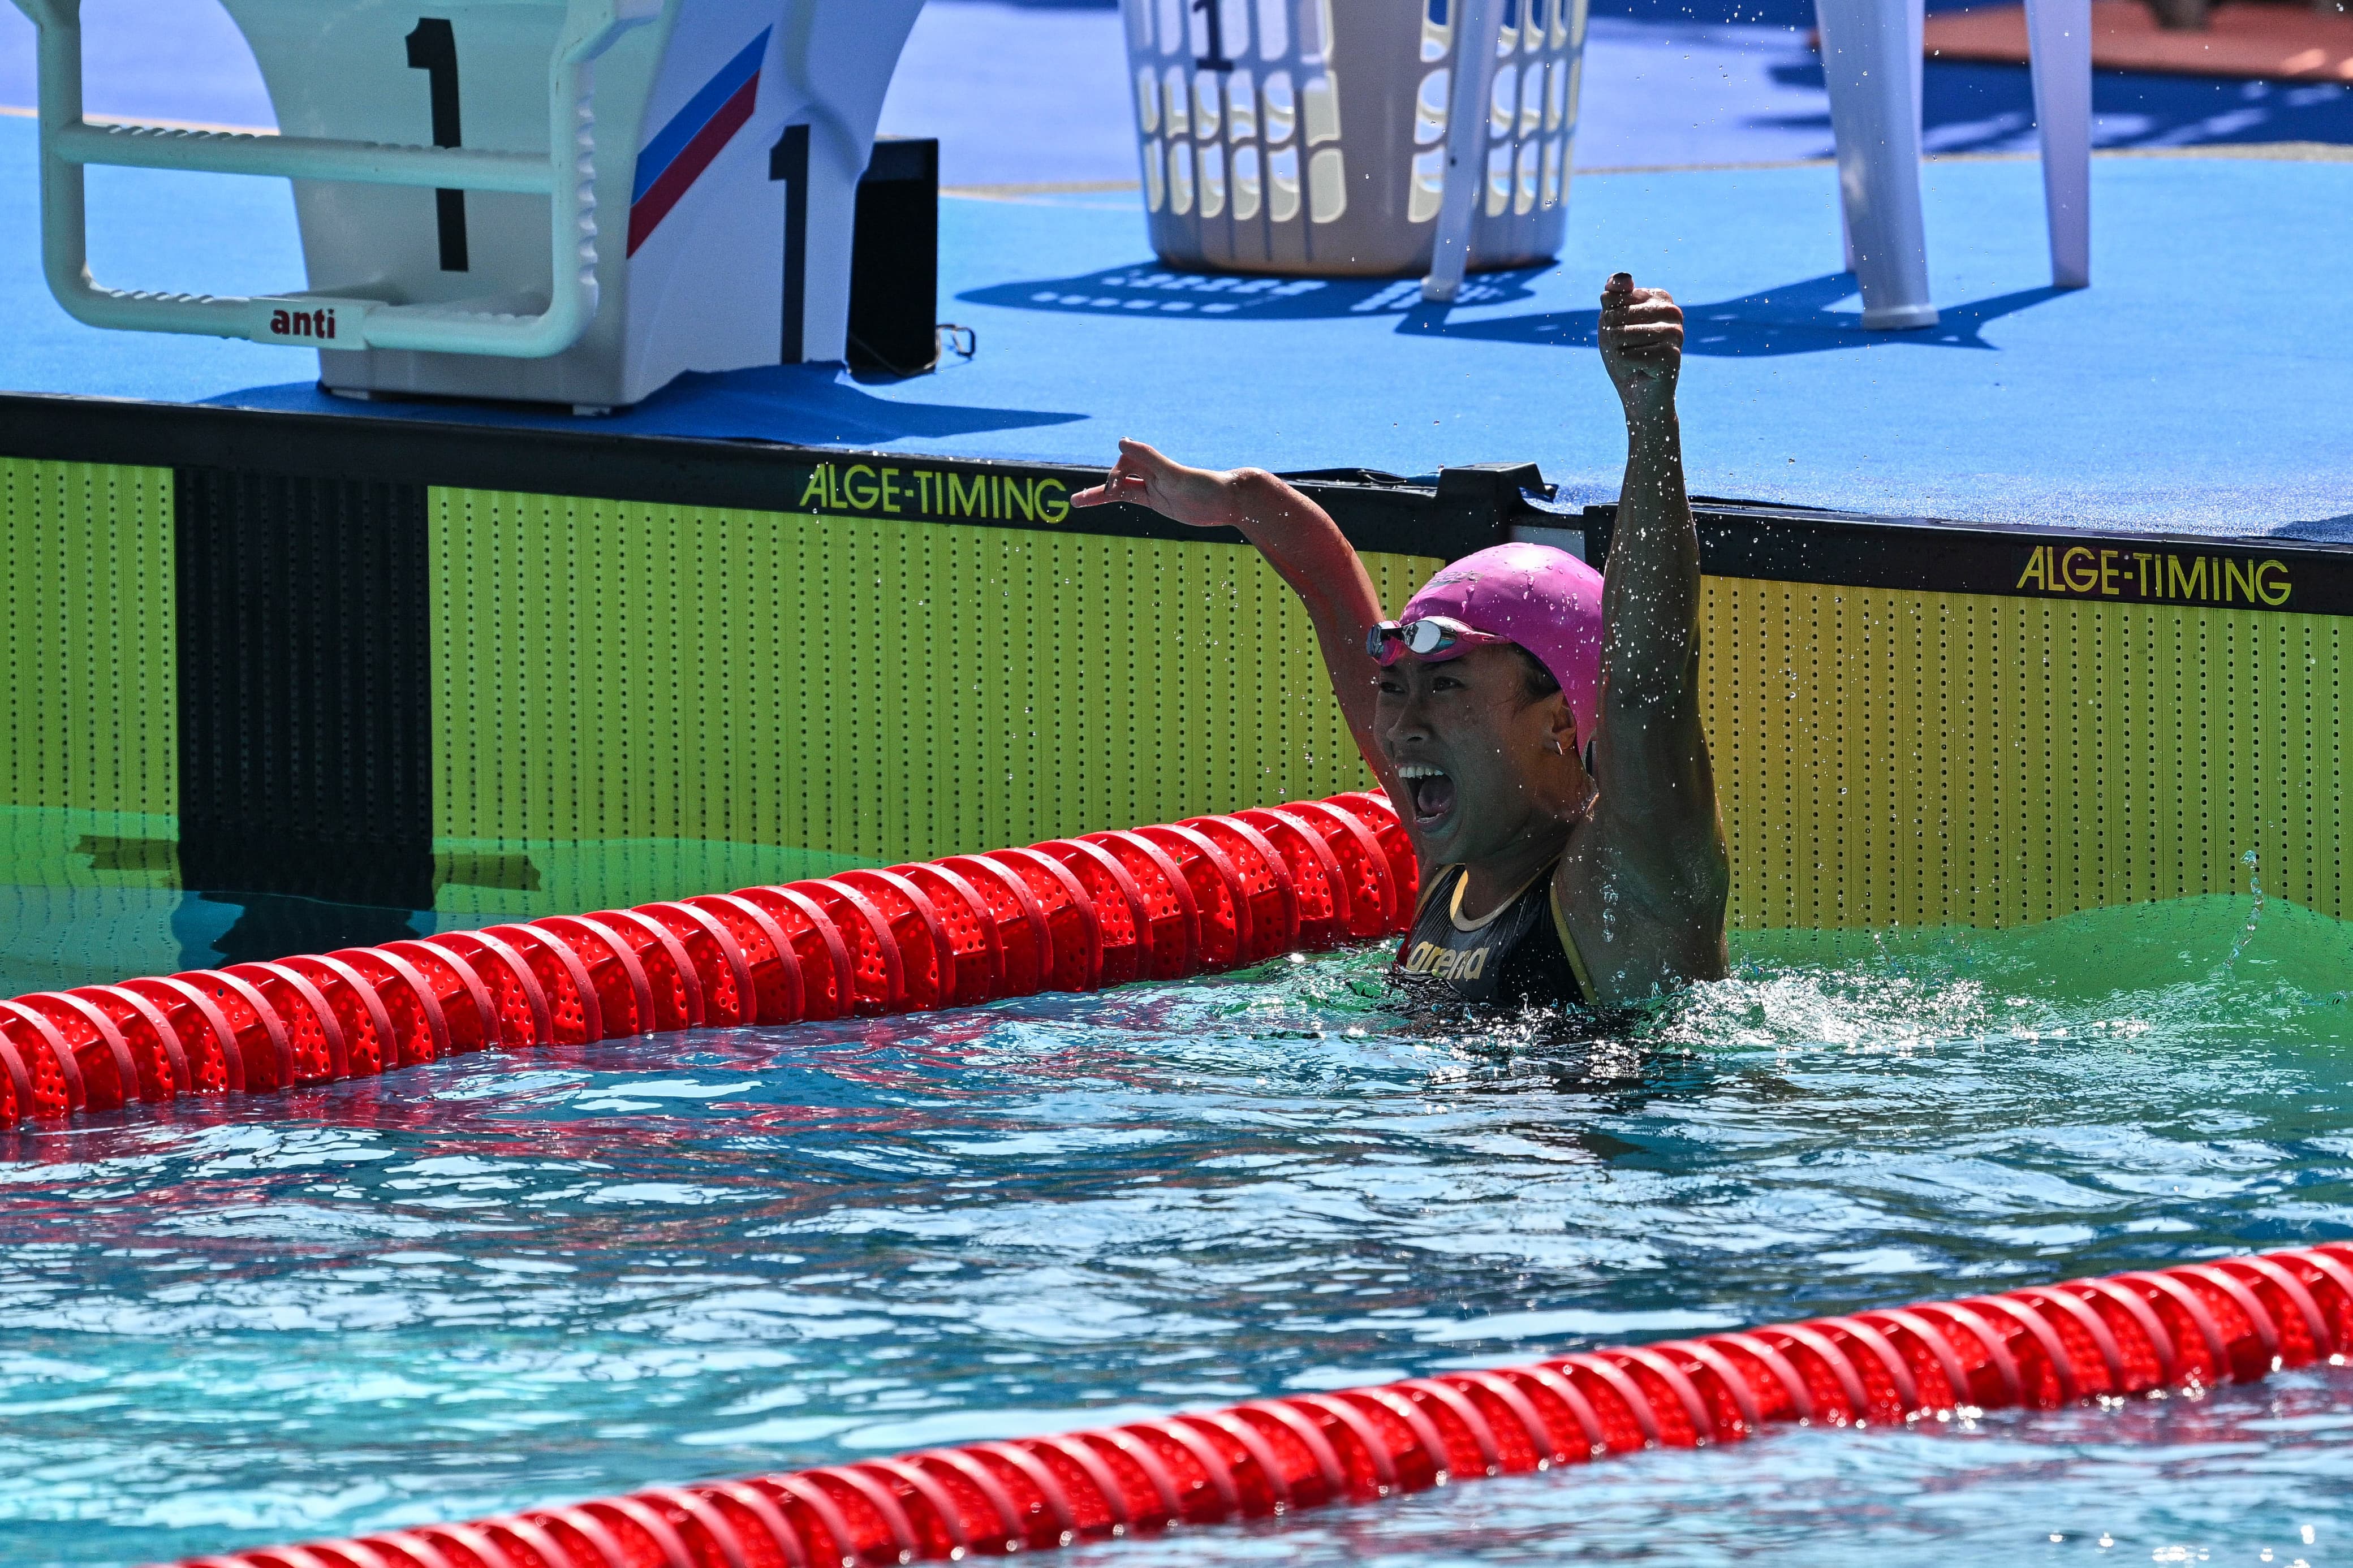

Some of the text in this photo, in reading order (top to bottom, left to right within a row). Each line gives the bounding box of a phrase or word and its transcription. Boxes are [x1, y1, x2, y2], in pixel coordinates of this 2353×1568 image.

[1193, 0, 1234, 71] 1
[405, 18, 468, 272] 1
[769, 124, 811, 365] 1
[270, 308, 335, 339] anti
[799, 463, 1070, 524] ALGE-TIMING
[2016, 546, 2292, 606] ALGE-TIMING
[1406, 941, 1489, 980] arena
